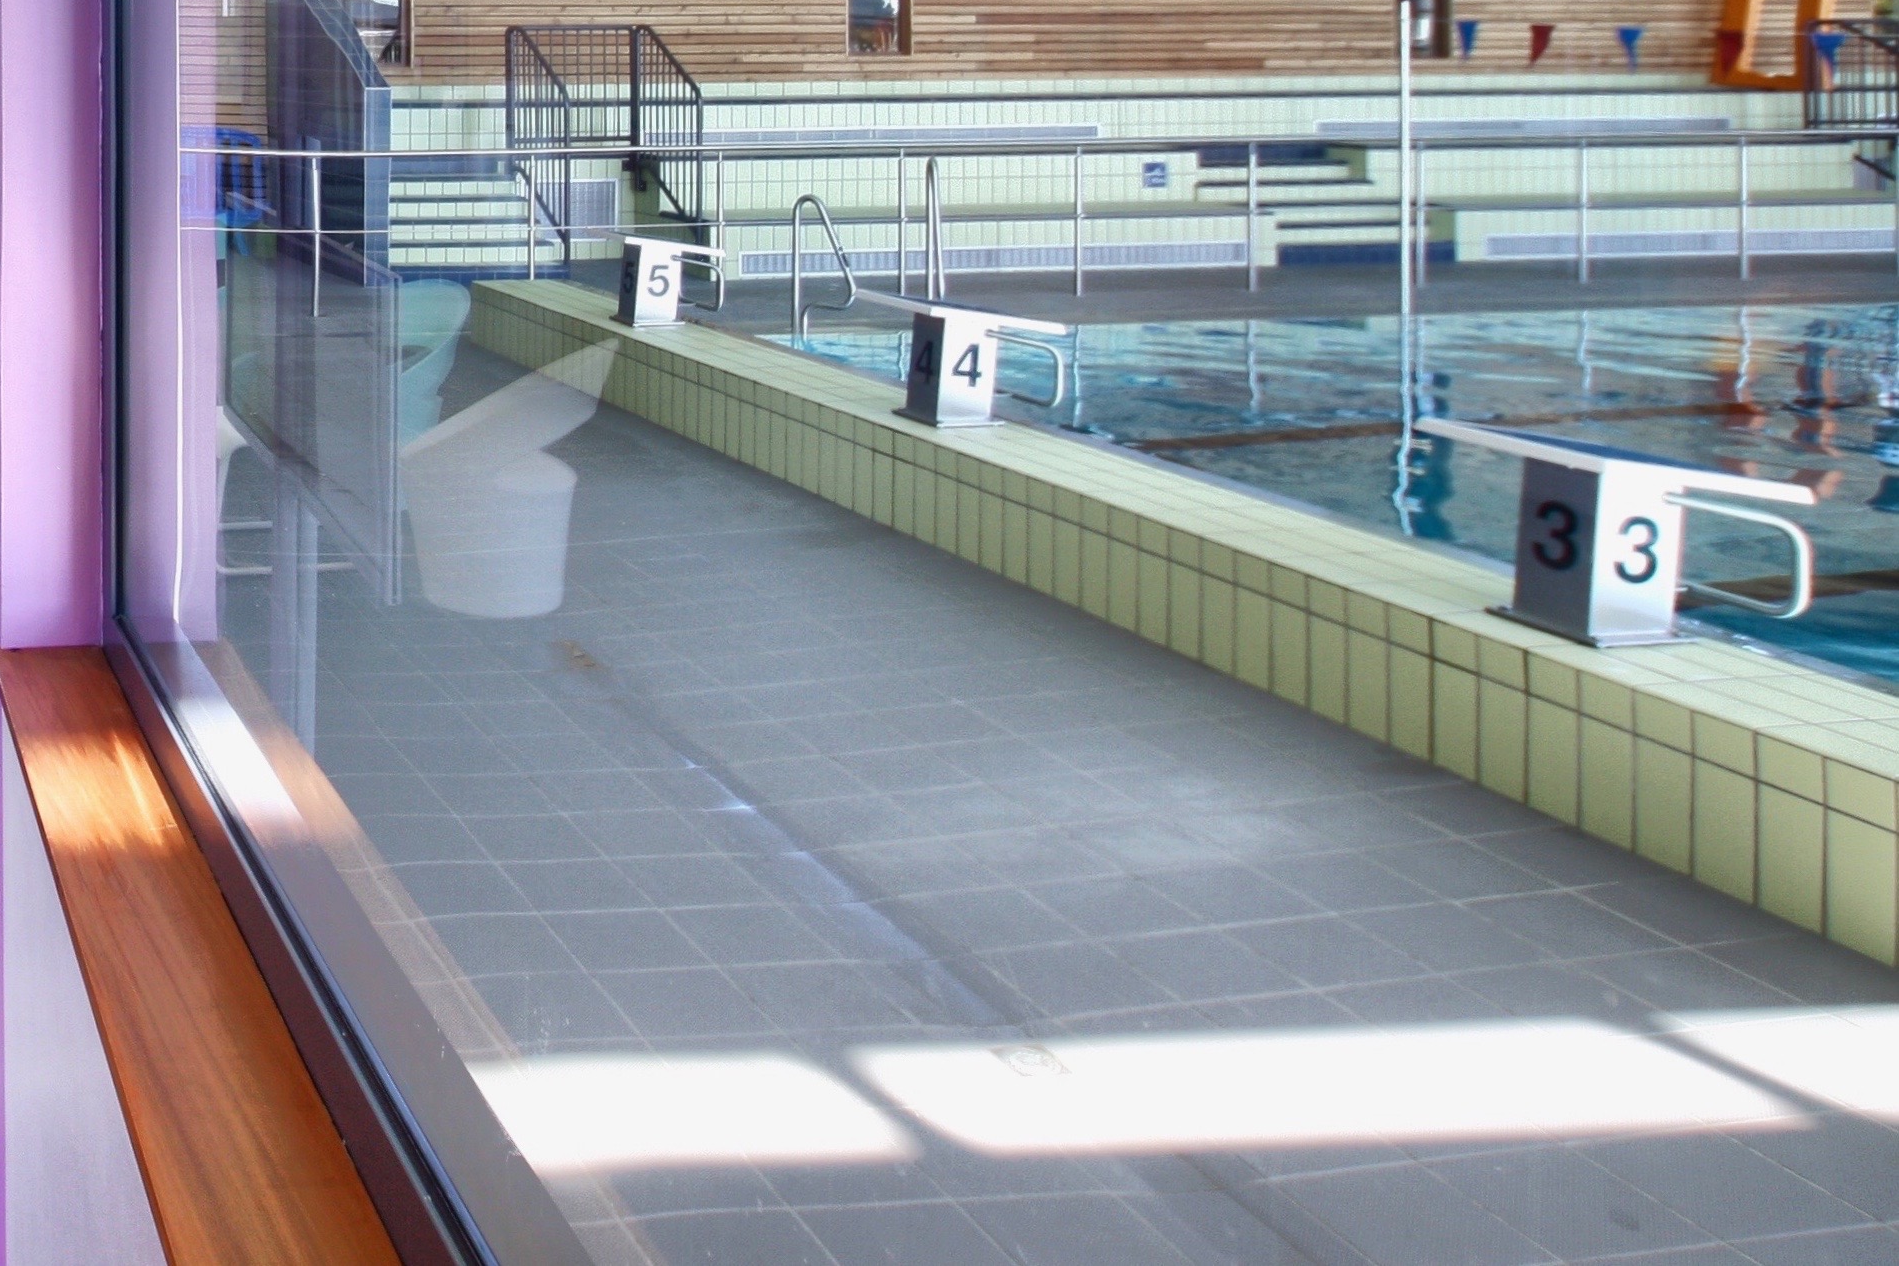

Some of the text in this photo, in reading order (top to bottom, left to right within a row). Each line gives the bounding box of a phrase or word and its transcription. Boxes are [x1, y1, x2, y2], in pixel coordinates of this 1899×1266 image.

[647, 265, 670, 297] 5
[915, 340, 934, 384] 4
[951, 343, 981, 387] 4
[1533, 501, 1577, 570] 3
[1614, 516, 1659, 584] 3
